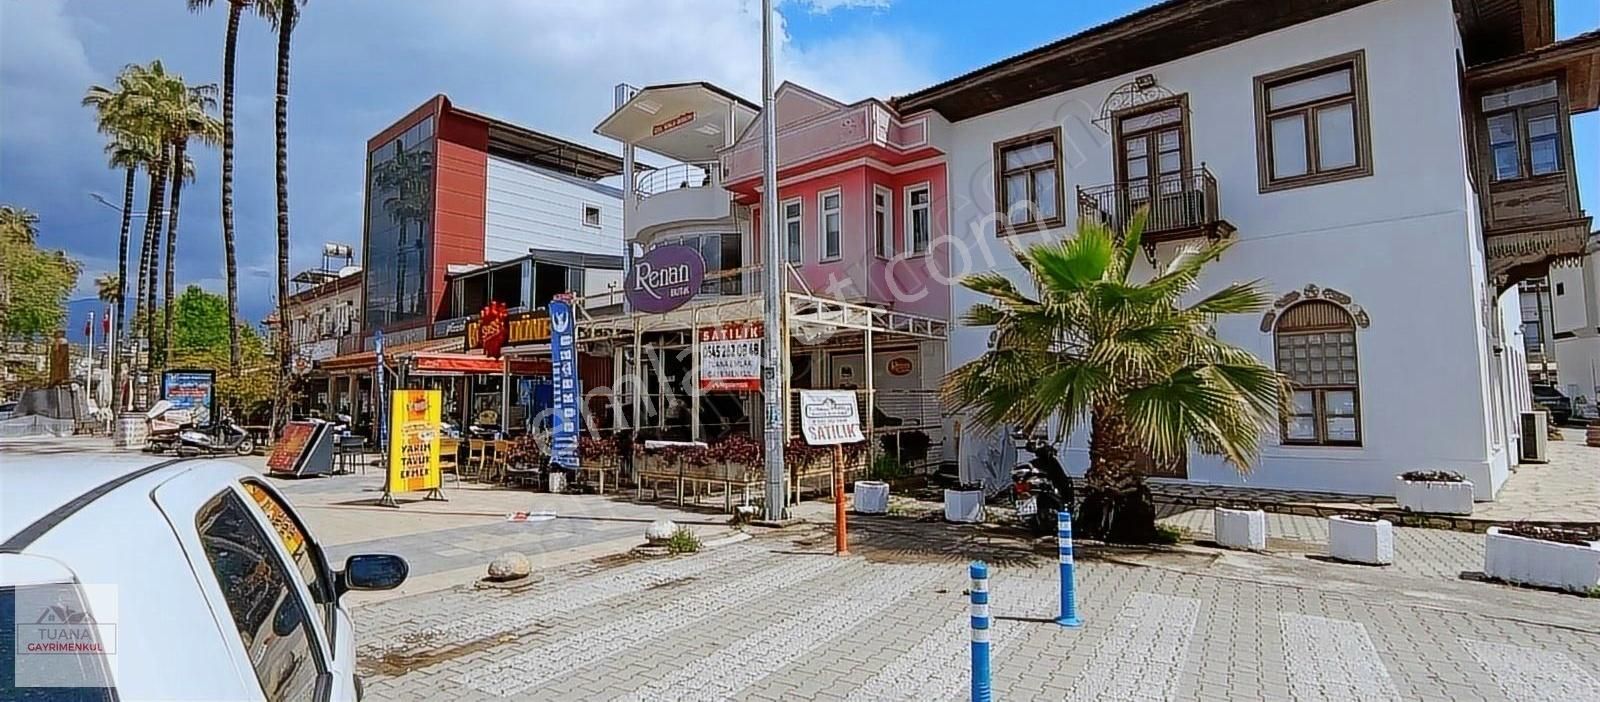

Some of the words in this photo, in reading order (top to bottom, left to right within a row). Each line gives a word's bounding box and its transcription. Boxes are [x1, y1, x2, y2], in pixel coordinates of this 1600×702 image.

[634, 262, 690, 300] Renan
[703, 326, 758, 341] SATILIK
[808, 424, 857, 440] SATILIK
